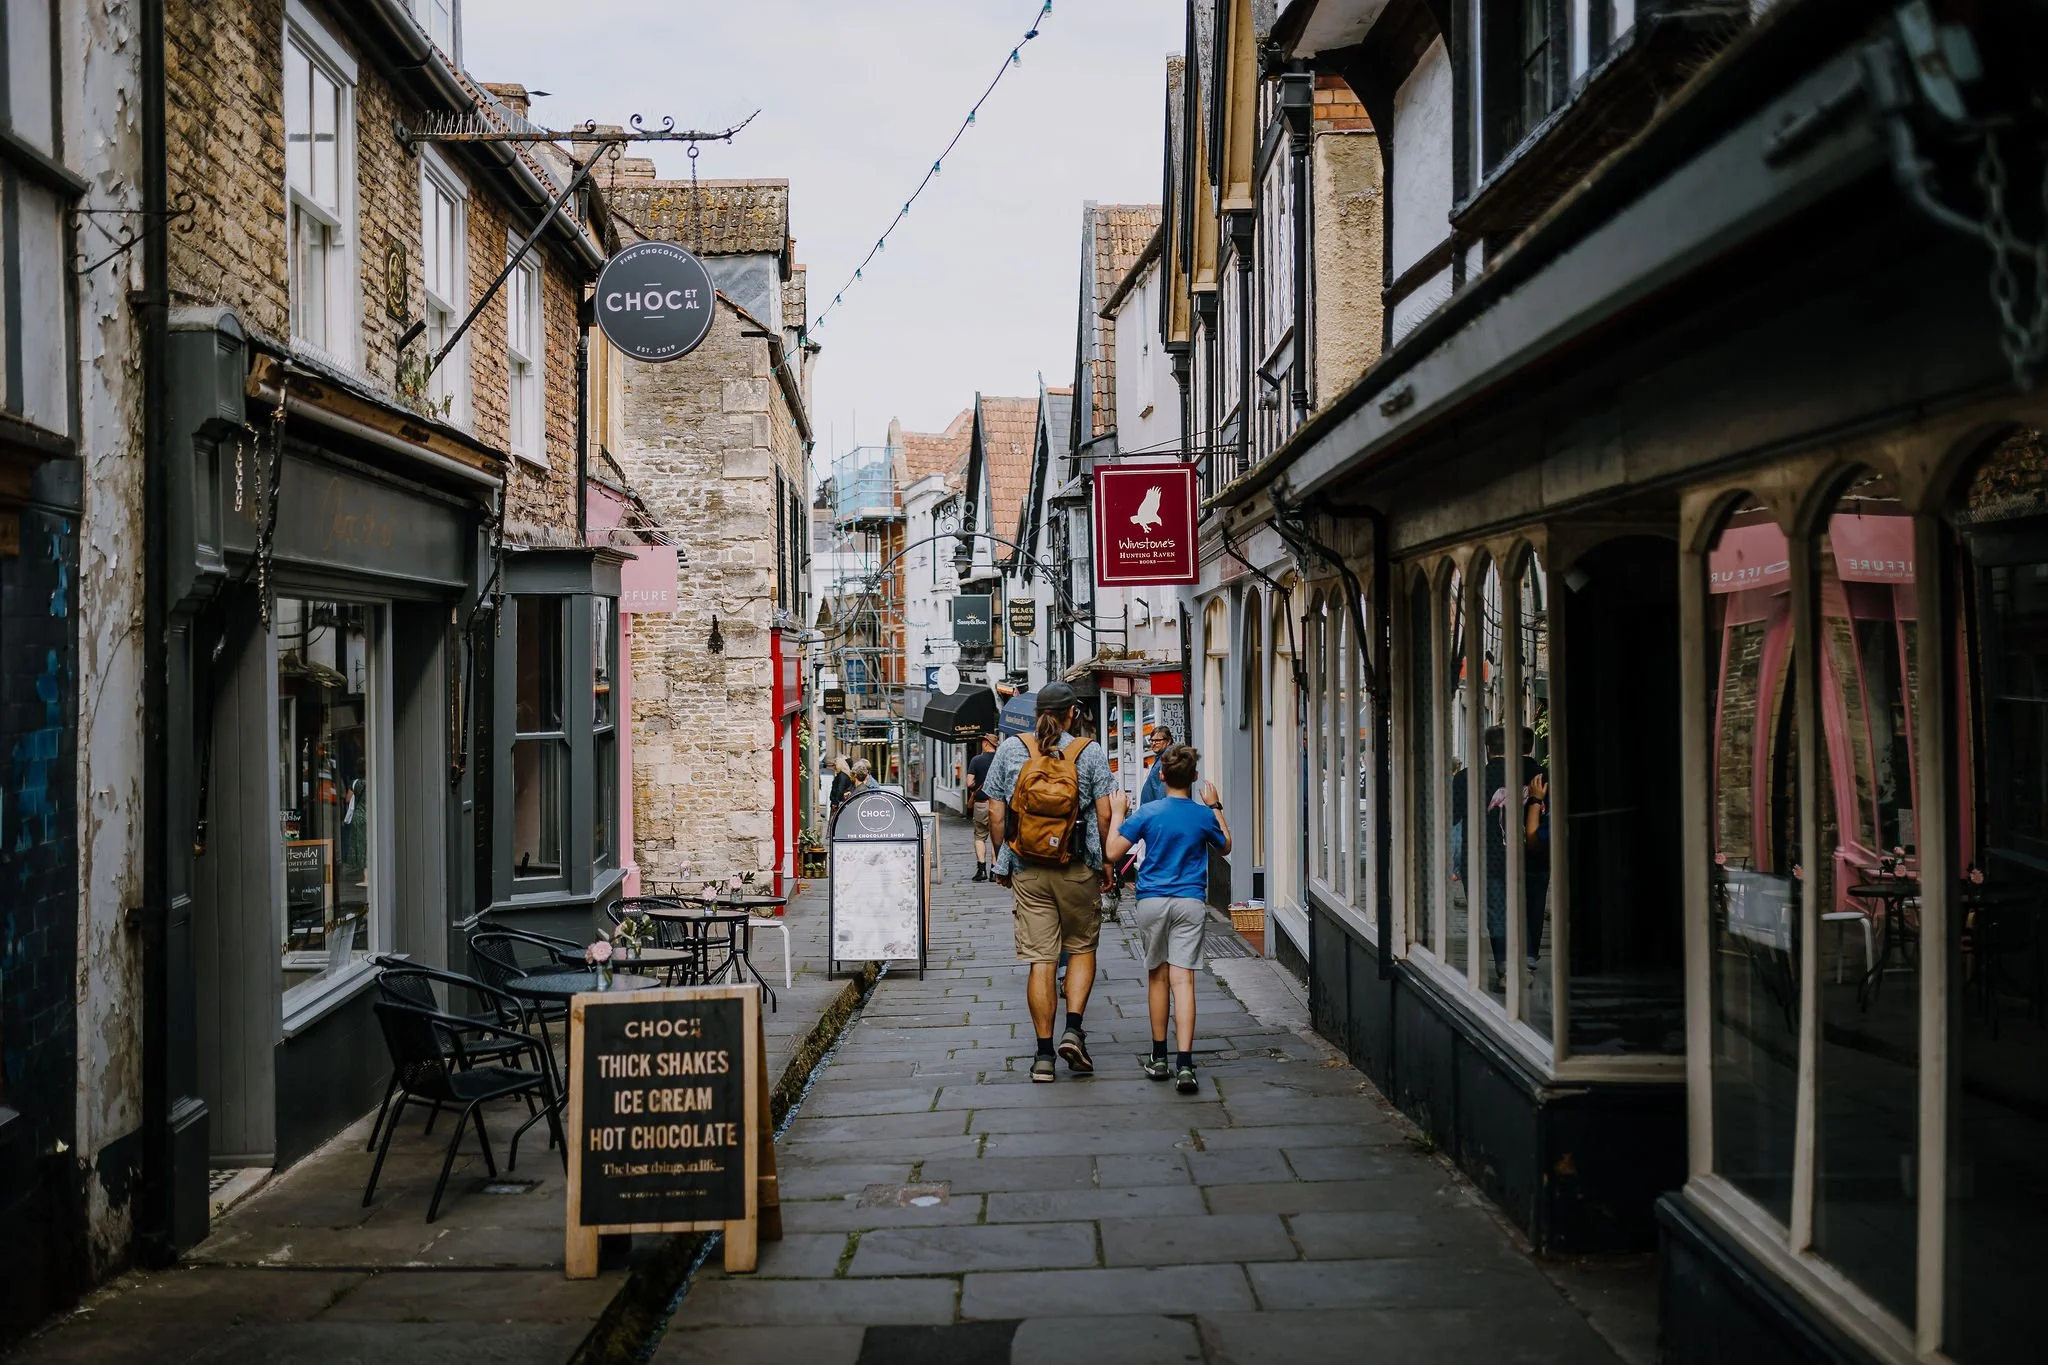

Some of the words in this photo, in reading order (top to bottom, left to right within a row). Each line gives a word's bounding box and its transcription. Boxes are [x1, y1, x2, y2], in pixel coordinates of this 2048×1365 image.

[620, 253, 637, 265] FINE
[640, 248, 687, 264] CHOCOLATE
[606, 291, 682, 312] CHOC
[685, 289, 698, 298] ET
[685, 300, 700, 310] AL
[636, 345, 653, 353] EST.
[657, 344, 676, 353] 2019
[1118, 537, 1176, 550] Winstone's
[861, 810, 885, 818] CHOC
[624, 1019, 688, 1038] CHOC
[598, 1054, 651, 1078] THICK
[656, 1051, 729, 1077] SHAKES
[614, 1089, 644, 1114] ICE
[648, 1087, 713, 1113] CREAM
[590, 1127, 625, 1151] HOT
[631, 1123, 738, 1150] CHOCOLATE
[602, 1163, 624, 1175] The
[626, 1162, 649, 1175] best
[651, 1161, 685, 1176] things
[687, 1161, 698, 1172] in
